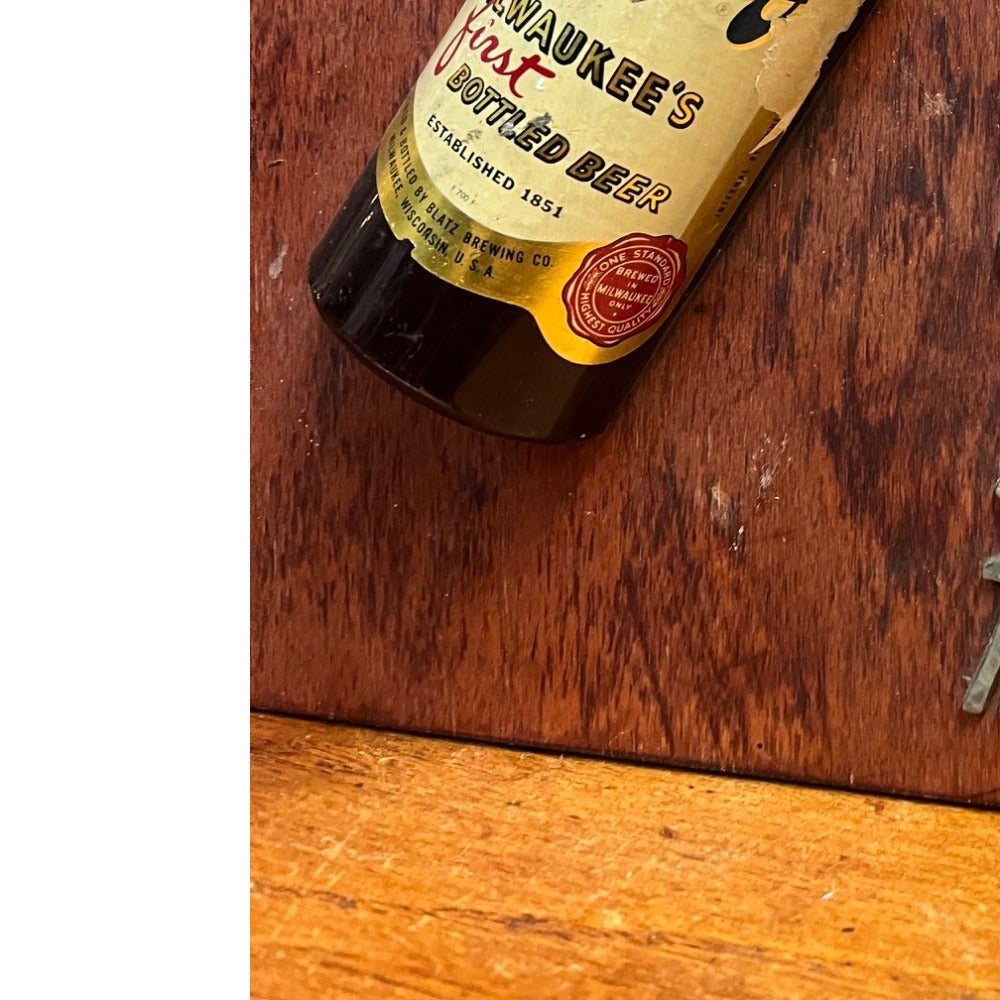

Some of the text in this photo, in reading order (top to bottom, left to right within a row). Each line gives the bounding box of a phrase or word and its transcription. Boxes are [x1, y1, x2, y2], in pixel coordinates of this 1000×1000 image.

[446, 62, 672, 214] BOTTLED BEER
[426, 114, 564, 218] ESTABLISHED 1851
[414, 186, 428, 203] BY
[425, 202, 459, 235] BLATZ
[462, 232, 524, 264] BREWING
[532, 253, 554, 268] CO.
[599, 249, 672, 286] ONE STANDARD
[615, 266, 659, 284] BREWED
[626, 281, 639, 289] IN
[596, 283, 654, 305] MILWAUKEE
[608, 300, 632, 311] ONLY
[581, 292, 653, 334] HIGHEST QUALITY
